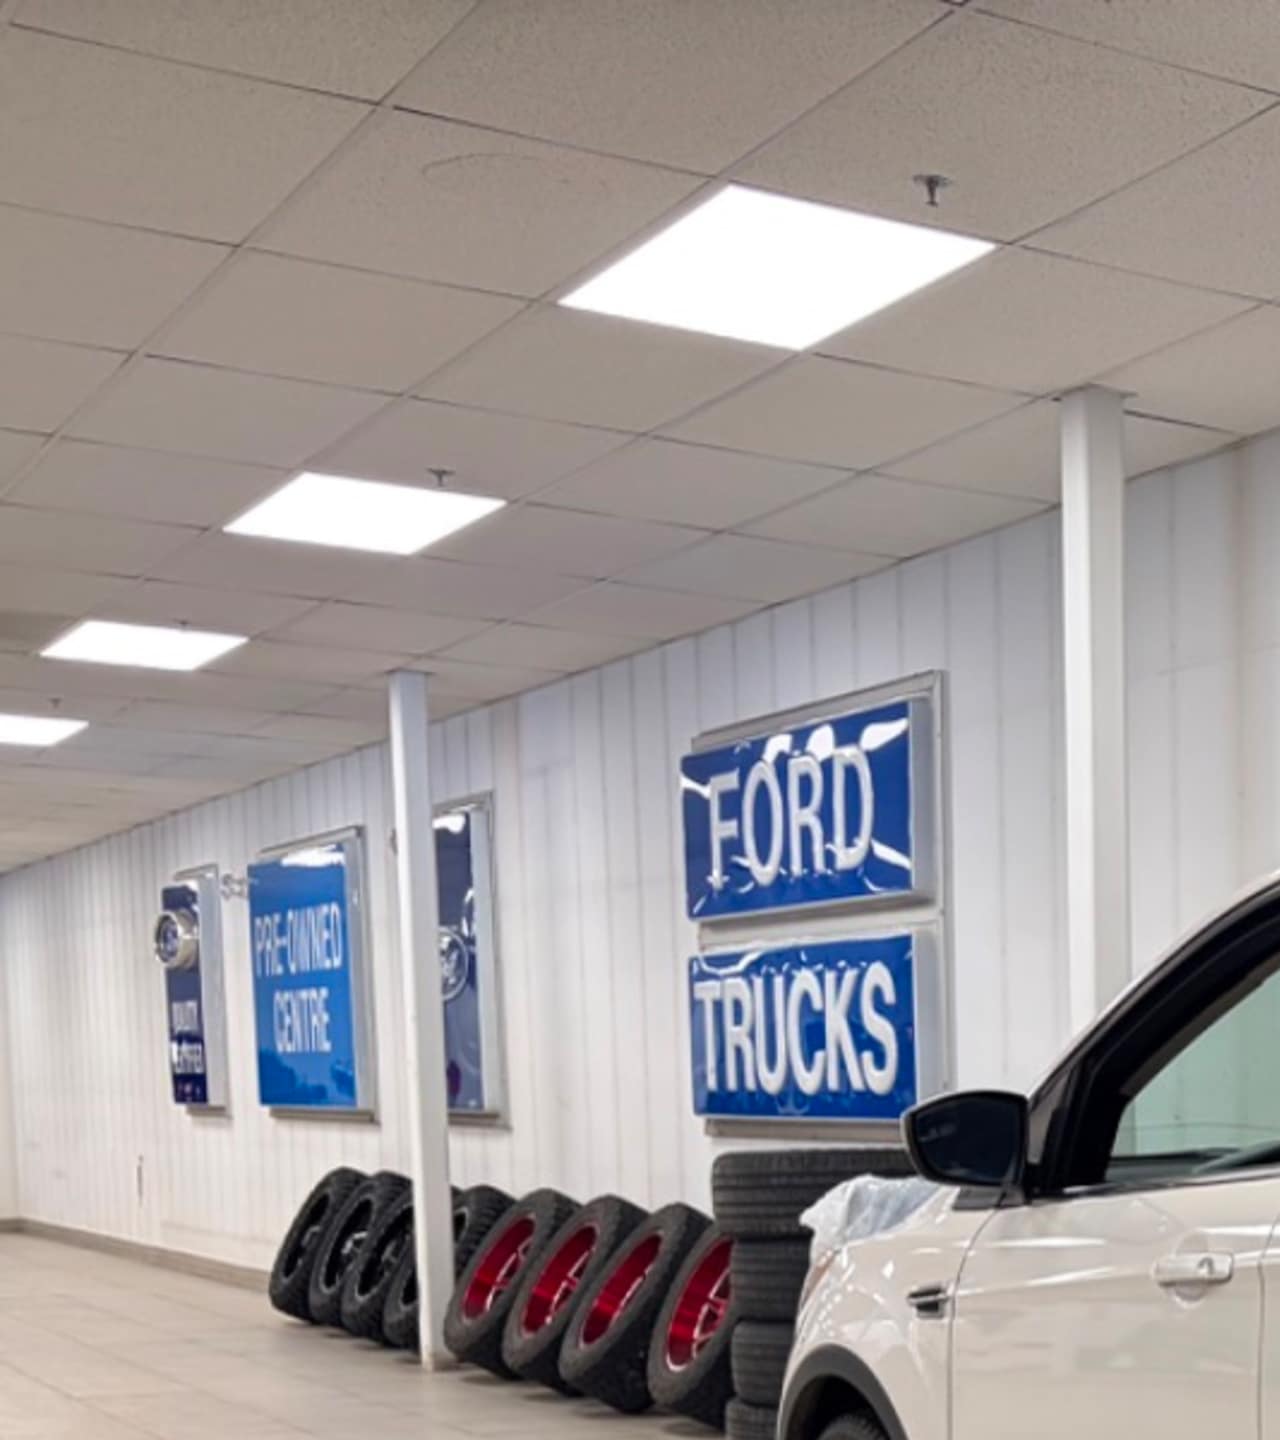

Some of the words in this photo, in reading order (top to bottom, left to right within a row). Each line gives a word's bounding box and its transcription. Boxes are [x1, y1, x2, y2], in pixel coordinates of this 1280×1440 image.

[706, 745, 874, 890] FORD
[253, 901, 343, 978] PRE-OWNED
[272, 986, 333, 1055] CENTRE
[693, 960, 897, 1096] TRUCKS
